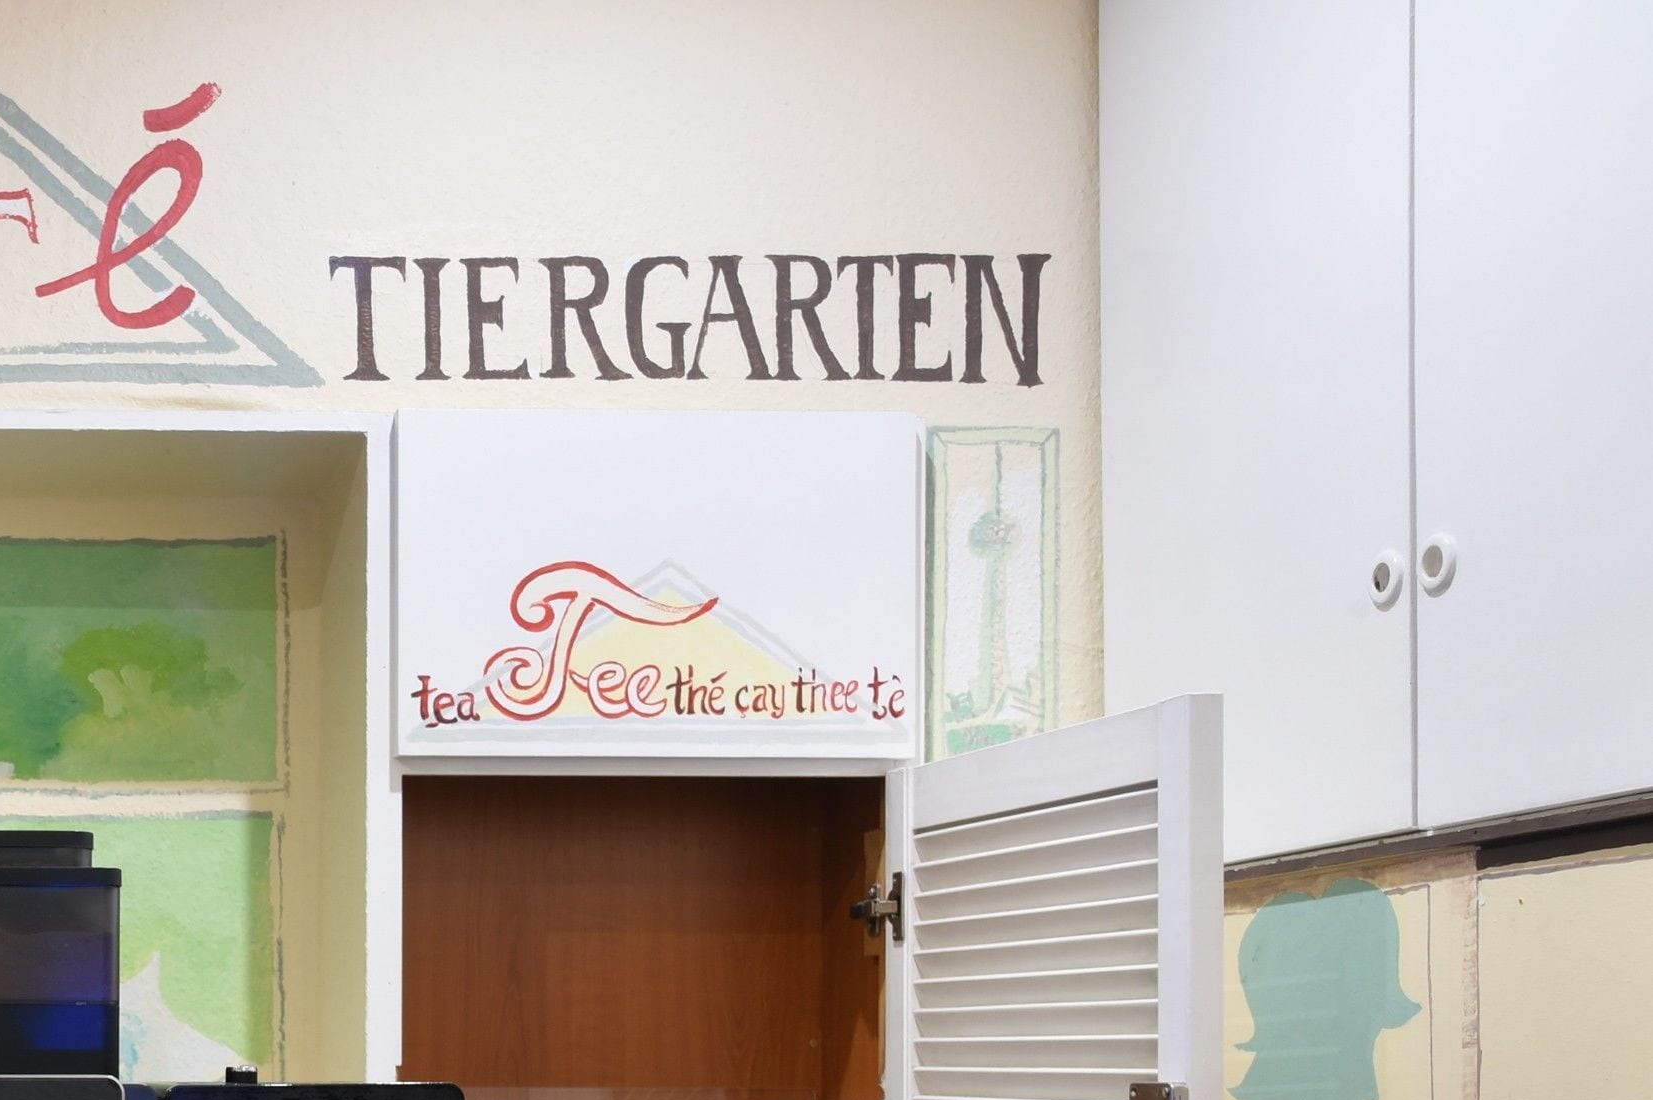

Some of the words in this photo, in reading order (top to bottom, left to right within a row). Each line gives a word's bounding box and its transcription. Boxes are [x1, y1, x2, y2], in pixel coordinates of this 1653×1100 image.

[329, 253, 1052, 388] TIERGARTEN
[411, 674, 480, 728] tea
[483, 560, 720, 721] Tee
[665, 664, 728, 716] thé
[791, 666, 860, 715] thee
